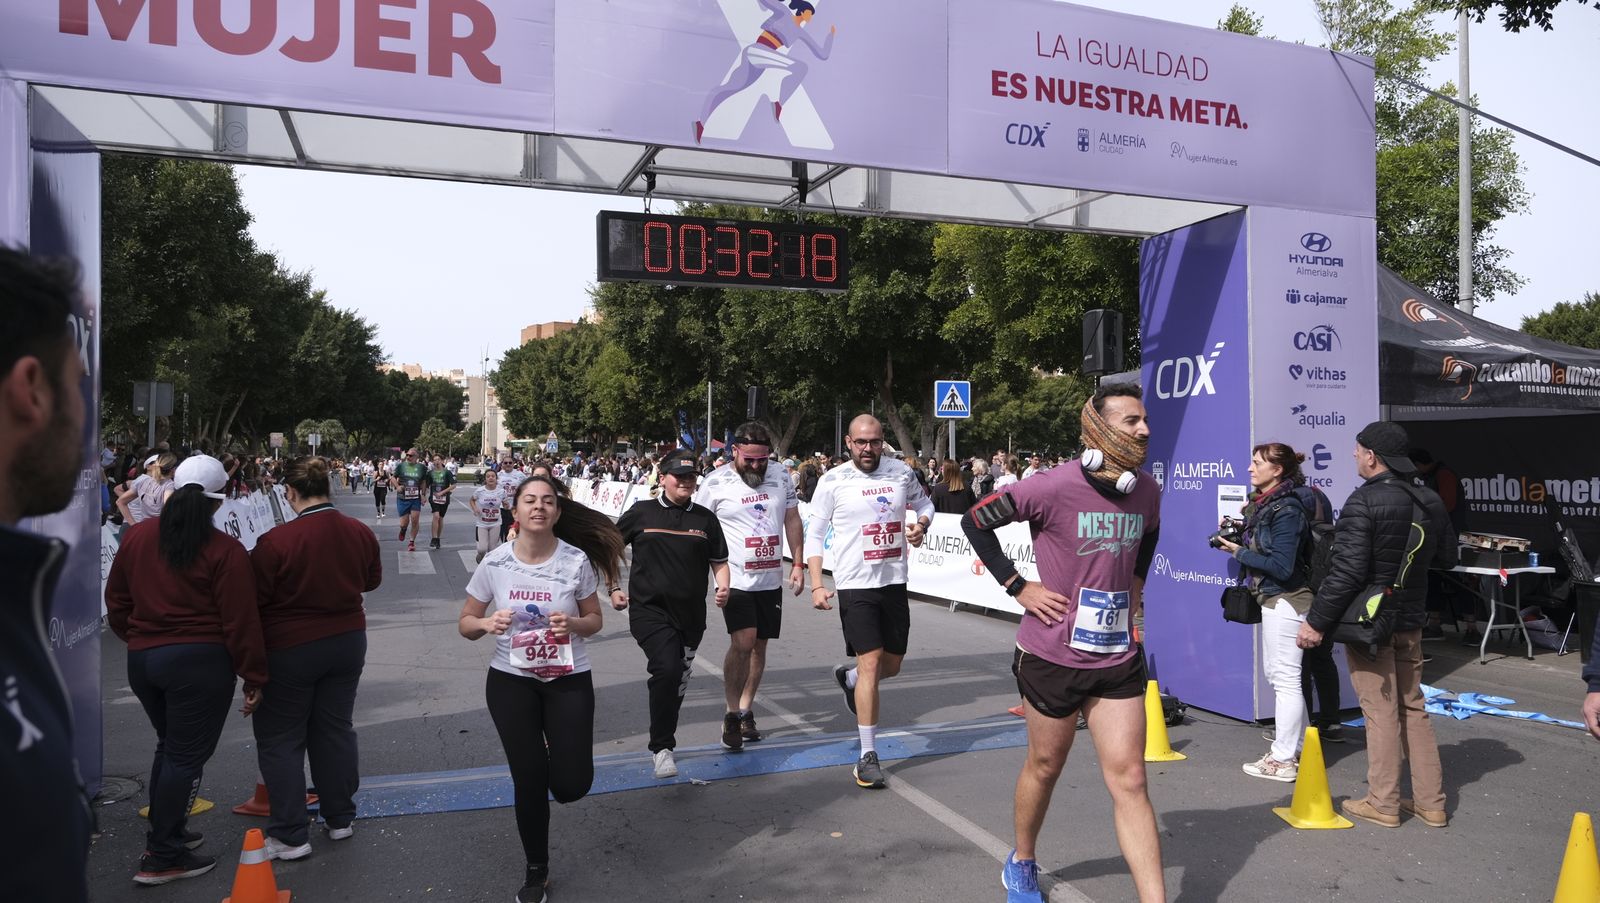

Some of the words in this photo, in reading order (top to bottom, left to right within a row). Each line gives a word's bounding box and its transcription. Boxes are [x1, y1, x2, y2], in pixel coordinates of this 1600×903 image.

[1036, 31, 1070, 61] LA
[1078, 37, 1209, 82] IGUALDAD
[991, 69, 1028, 100] ES
[1035, 75, 1164, 119] NUESTRA
[1170, 96, 1249, 129] META.
[1005, 122, 1051, 148] CDX
[1099, 131, 1147, 149] ALMERÍA
[644, 221, 837, 282] 00:32:18
[1289, 254, 1344, 268] HYUNDAI
[1303, 292, 1348, 307] cajamar
[1293, 331, 1332, 352] CASI
[1155, 342, 1225, 400] CDX
[1306, 366, 1346, 381] vithas
[1299, 411, 1346, 429] aqualia
[1173, 458, 1234, 478] ALMERÍA
[862, 486, 895, 496] MUJER
[1173, 479, 1203, 490] CIUDAD
[741, 493, 770, 504] MUJER
[1077, 511, 1144, 539] MESTIZO
[873, 533, 895, 546] 610
[920, 532, 972, 556] ALMERÍA
[755, 546, 775, 557] 698
[918, 552, 945, 567] CIUDAD
[509, 590, 552, 602] MUJER
[1095, 609, 1120, 626] 161
[525, 645, 558, 662] 942
